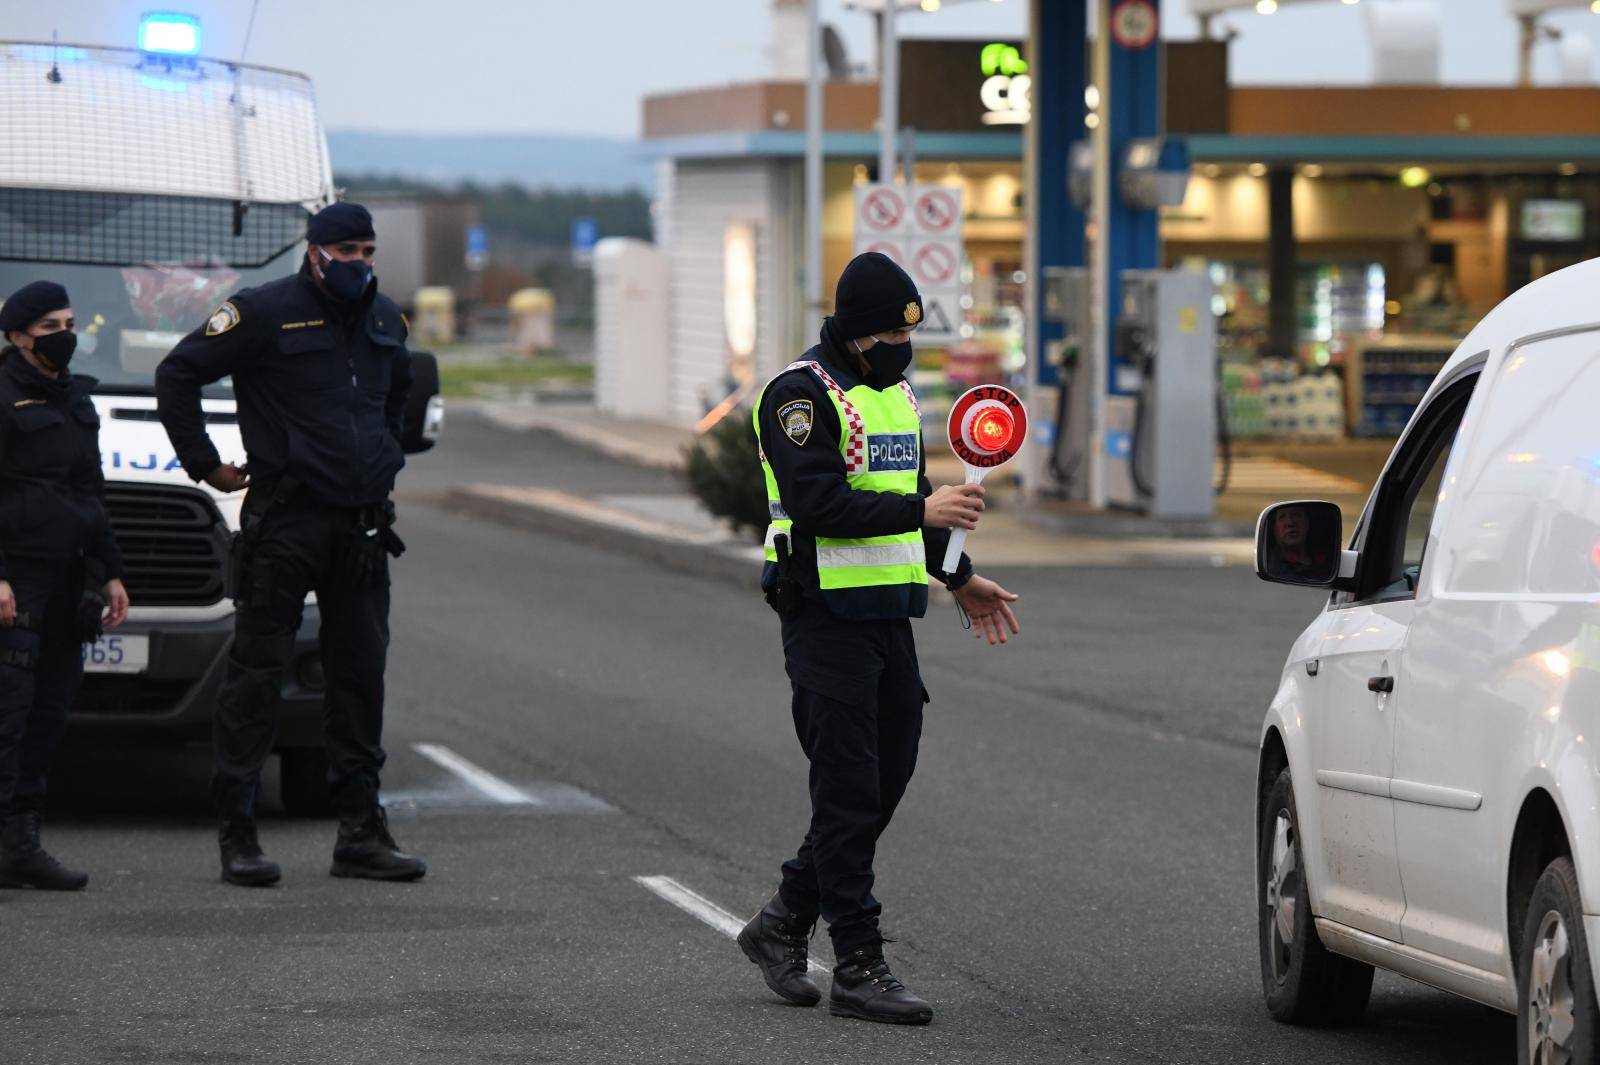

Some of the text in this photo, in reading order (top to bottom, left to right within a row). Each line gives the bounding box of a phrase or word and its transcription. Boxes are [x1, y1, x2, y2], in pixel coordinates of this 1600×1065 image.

[973, 387, 1020, 407] STOP
[781, 403, 810, 417] POLICIJA
[952, 439, 1012, 467] POLICIJA
